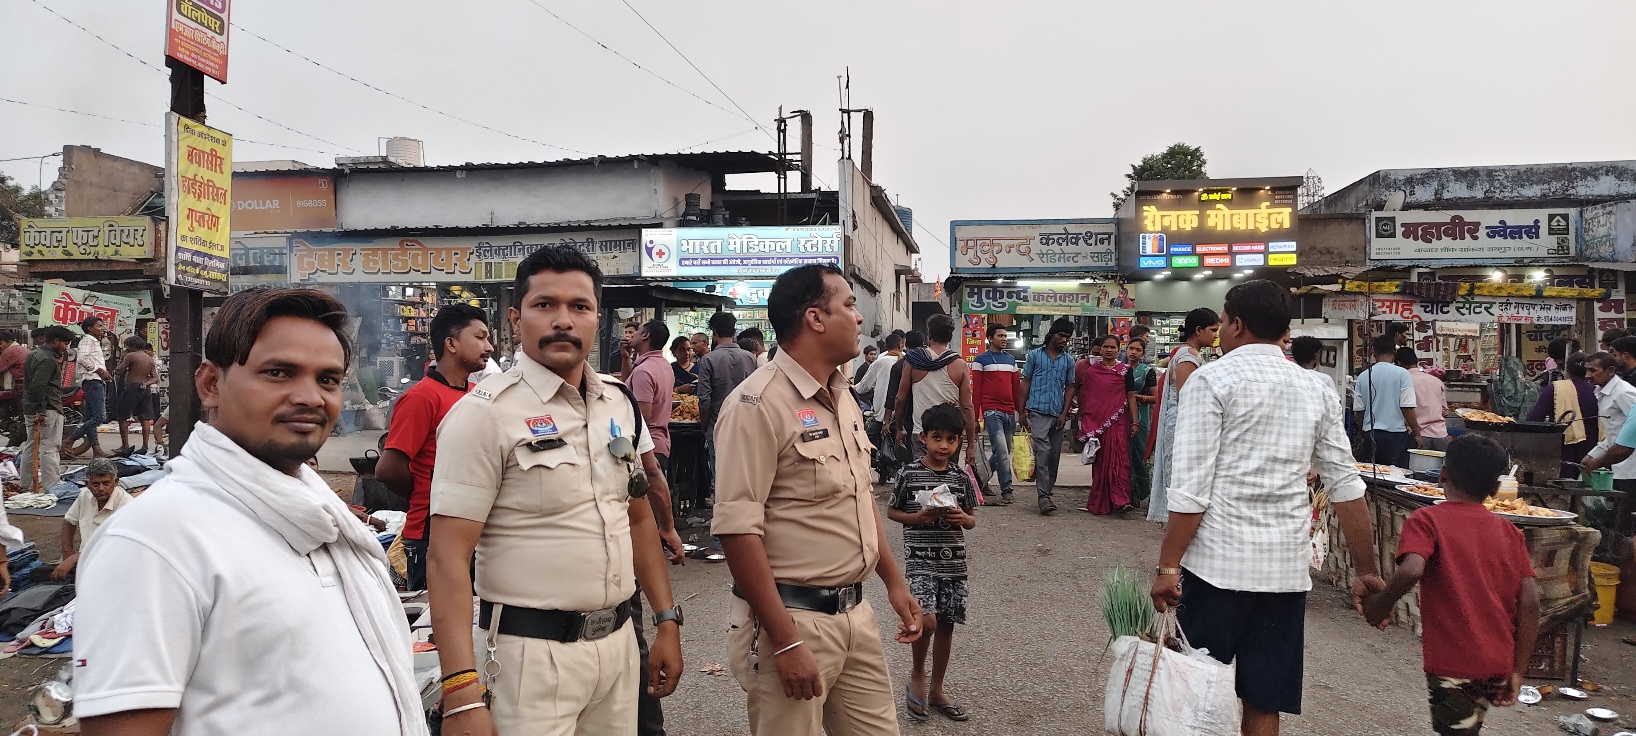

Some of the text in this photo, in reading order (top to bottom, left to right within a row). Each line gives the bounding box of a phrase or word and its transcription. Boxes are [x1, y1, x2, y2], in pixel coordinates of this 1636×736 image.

[187, 144, 225, 175] बवासीर
[237, 199, 327, 210] DOLLAR BIGBOSS
[187, 207, 221, 233] गुप्तरोग
[1142, 202, 1292, 232] रौनक मोबाईल
[1400, 214, 1541, 244] महावीर ज्वेलर्स
[23, 220, 146, 256] केवल फूट वियर
[180, 233, 188, 243] का
[599, 239, 637, 254] सामान
[680, 231, 841, 254] भारत मेडिकल स्टोर्स
[959, 227, 1114, 265] मुकुन्द कलेक्शन
[1036, 248, 1082, 263] रेडिमेन्ट
[1089, 248, 1115, 265] साड़ी
[1142, 258, 1165, 266] vivo
[1174, 257, 1197, 265] oppo
[965, 284, 1092, 309] मुकुन्द कलेक्शन
[1371, 298, 1423, 321] साहू
[1419, 299, 1454, 315] चाट
[1455, 296, 1496, 316] सेंटर
[1498, 298, 1513, 314] दही
